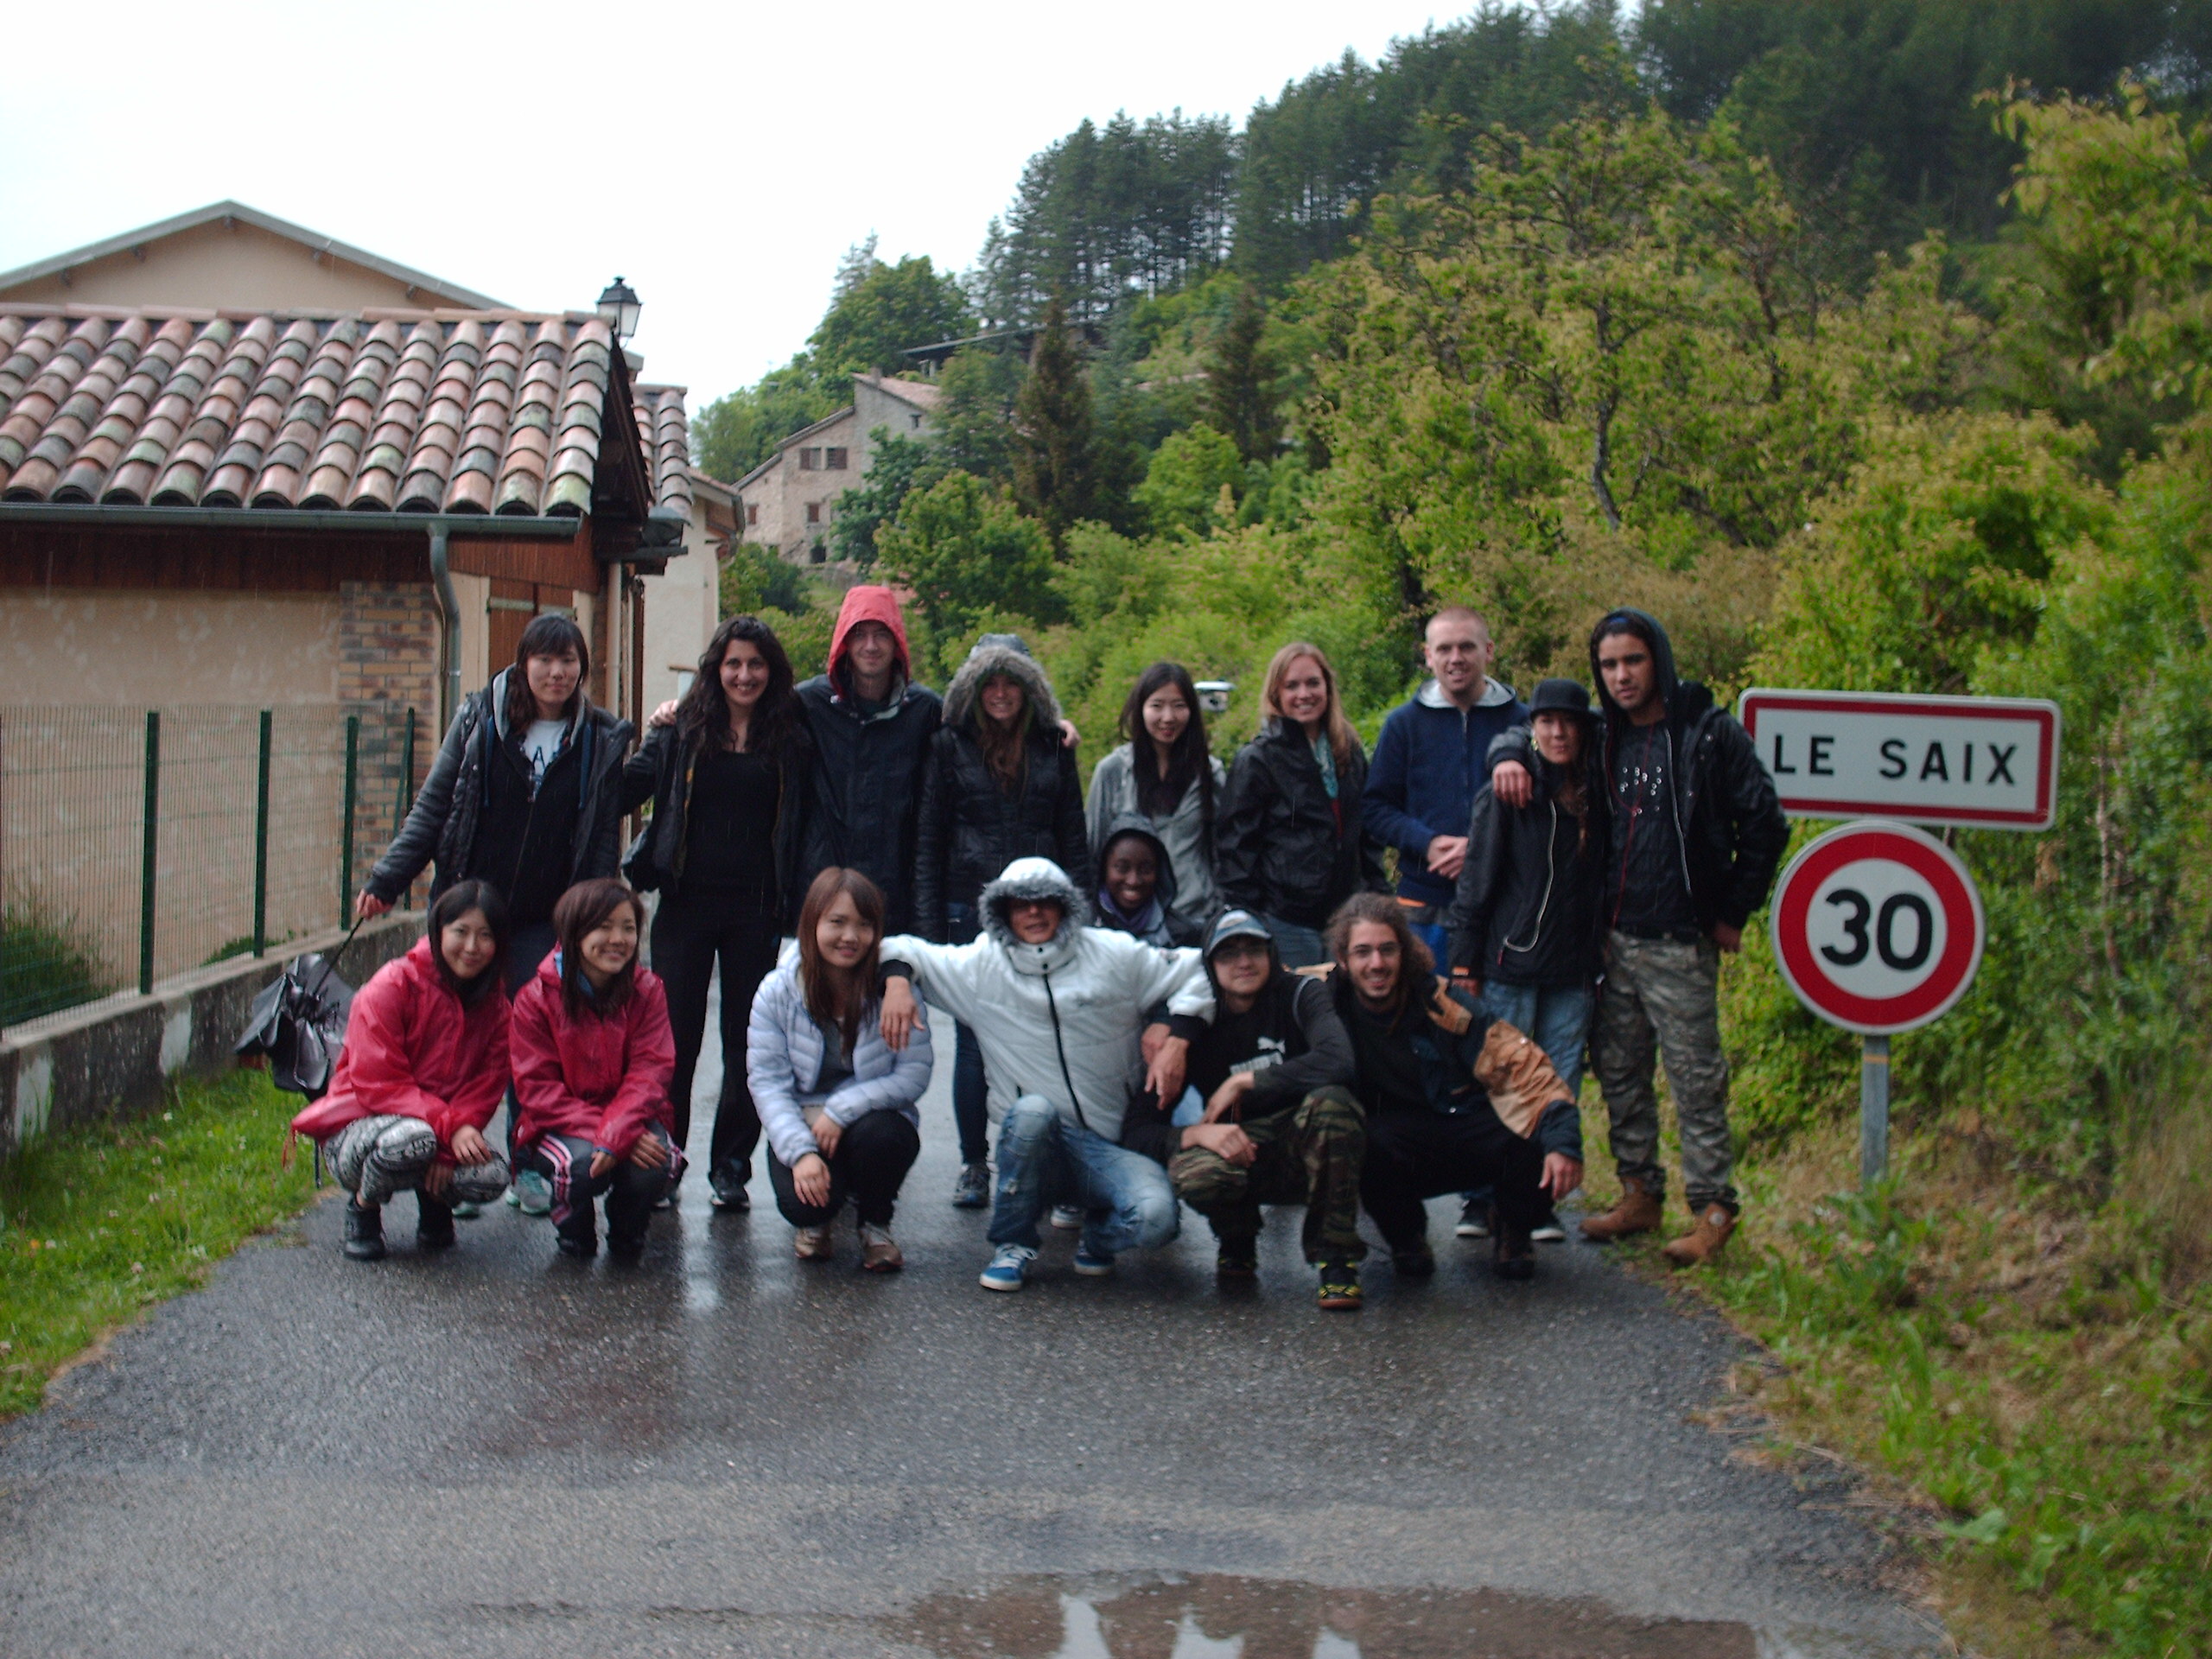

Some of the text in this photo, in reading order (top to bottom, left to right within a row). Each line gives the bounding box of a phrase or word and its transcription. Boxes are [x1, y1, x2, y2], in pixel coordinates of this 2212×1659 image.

[1773, 734, 2018, 785] LE SAIX
[1820, 887, 1934, 972] 30
